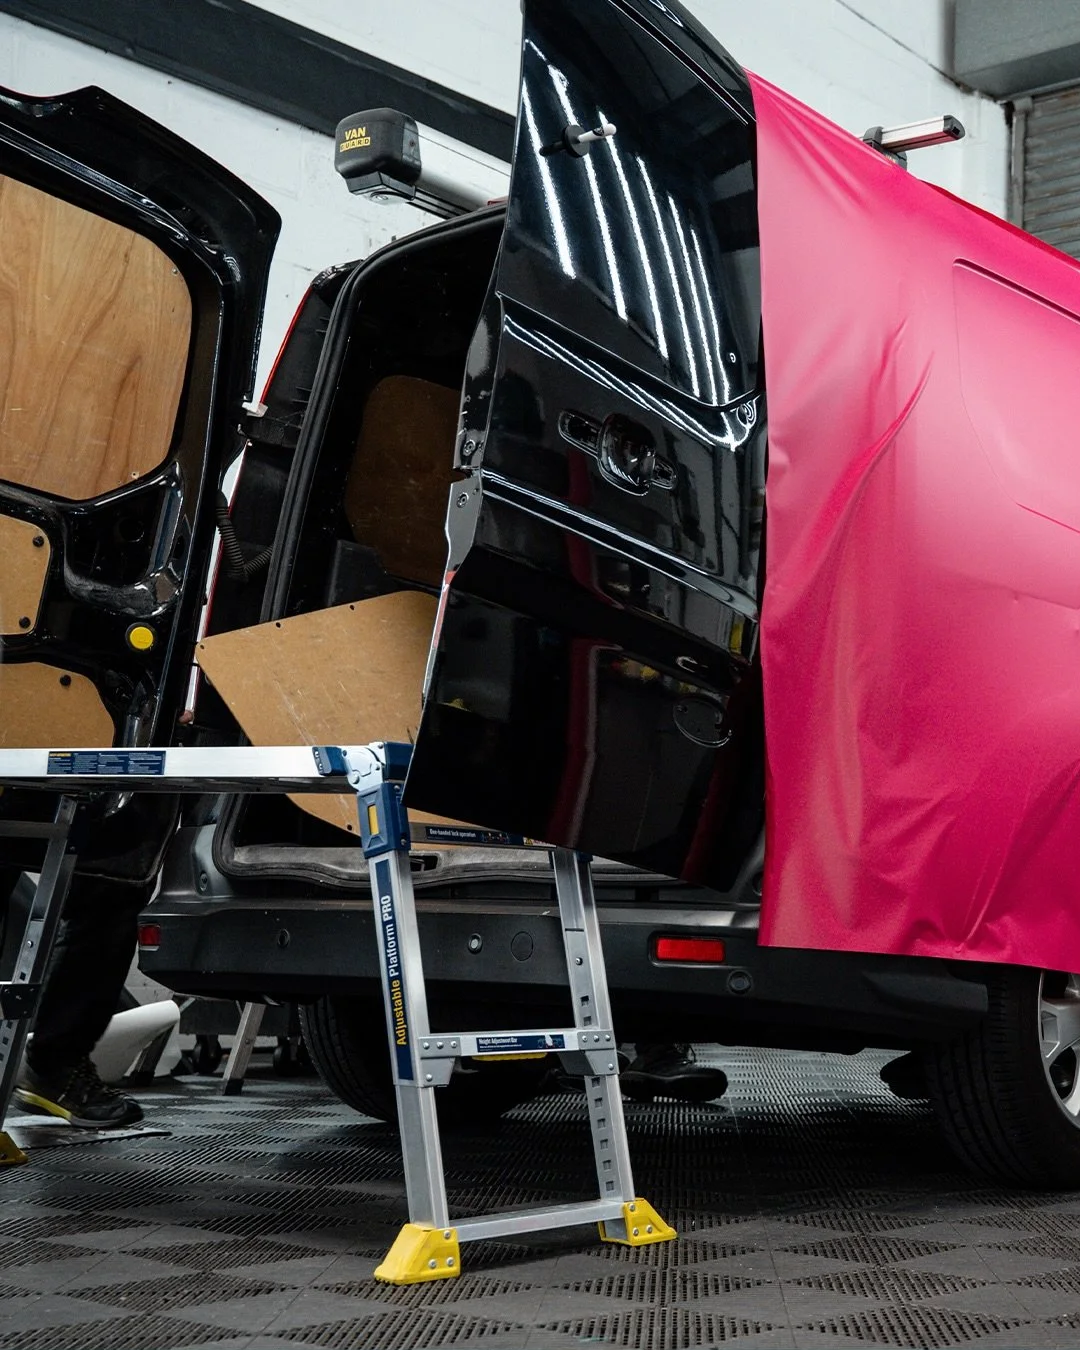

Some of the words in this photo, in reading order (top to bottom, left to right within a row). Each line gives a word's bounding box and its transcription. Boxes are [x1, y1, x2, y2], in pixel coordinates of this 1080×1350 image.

[340, 137, 370, 152] GUARD
[345, 127, 366, 140] VAN
[381, 895, 393, 921] PRO
[384, 924, 399, 977] Platform
[391, 979, 407, 1046] Adjustable
